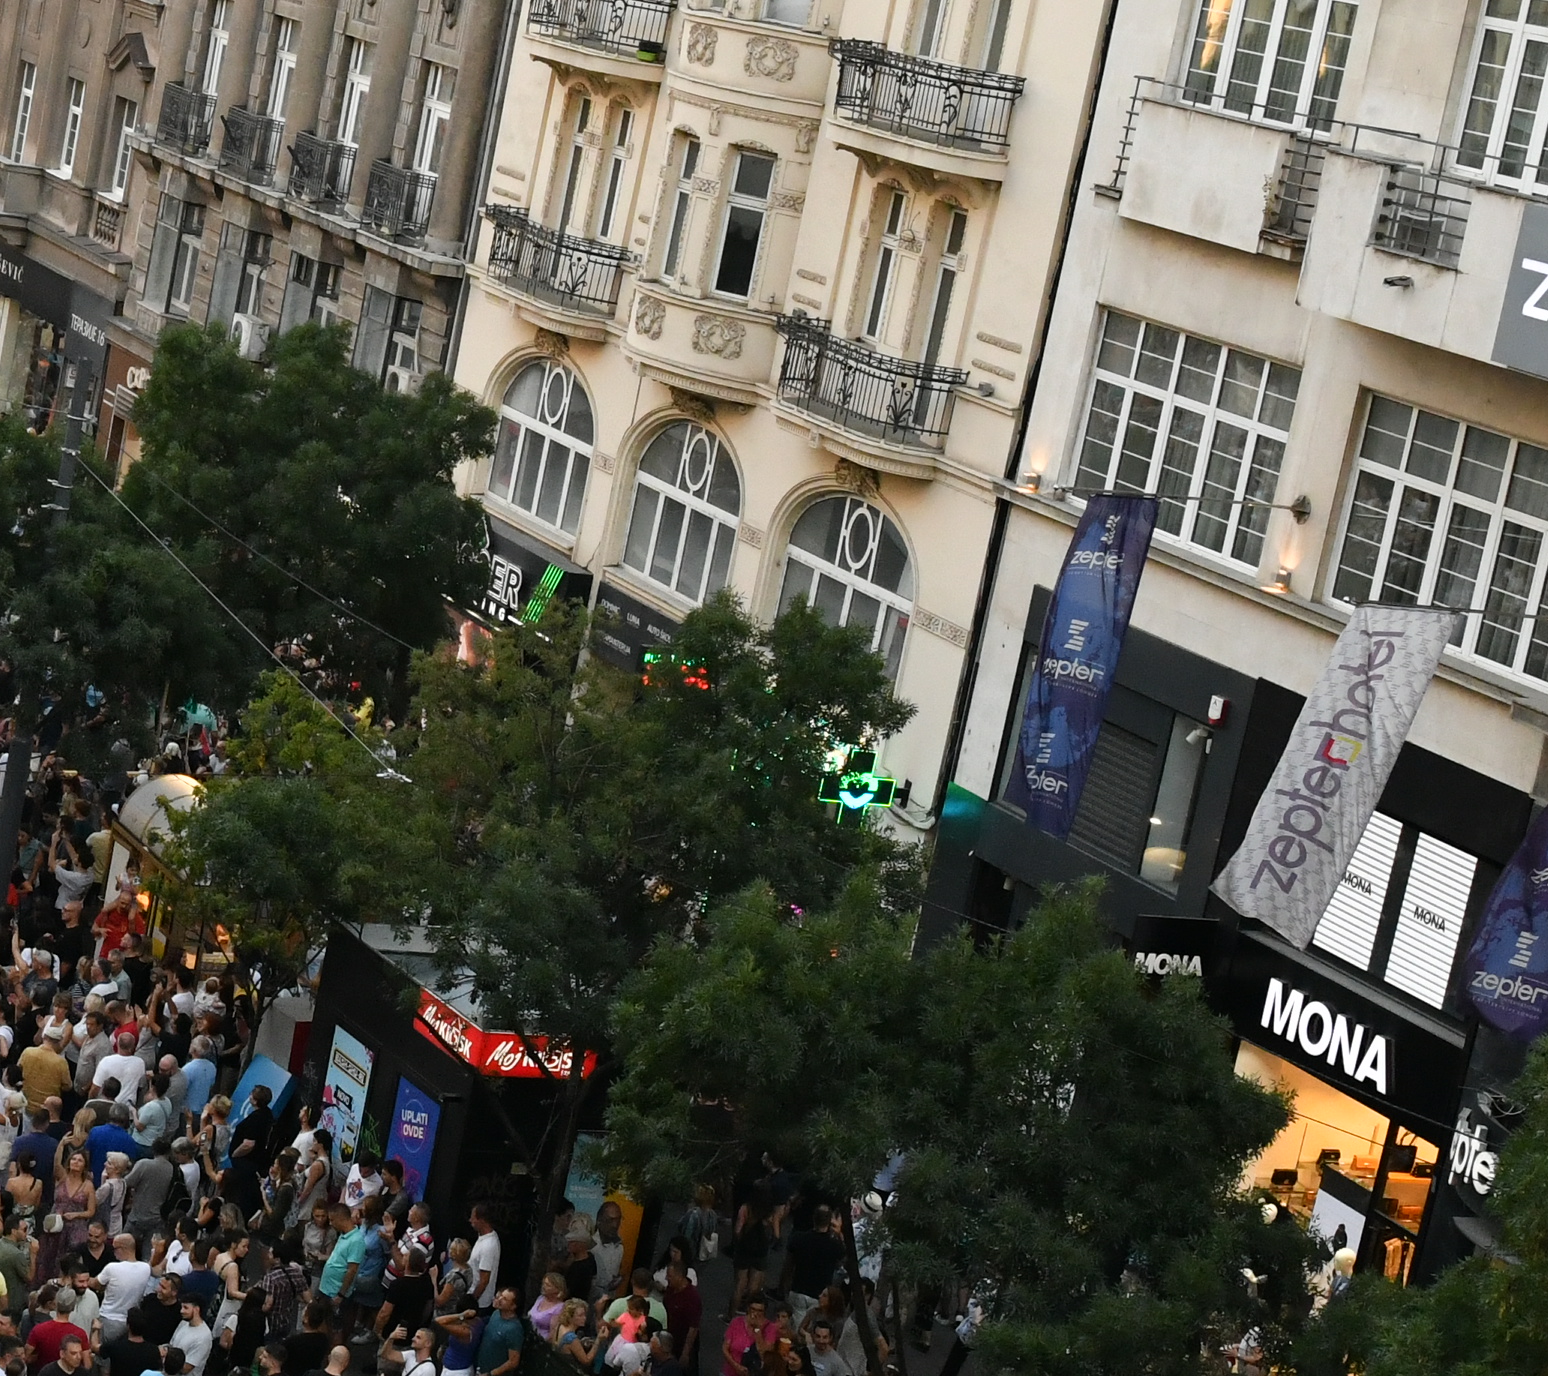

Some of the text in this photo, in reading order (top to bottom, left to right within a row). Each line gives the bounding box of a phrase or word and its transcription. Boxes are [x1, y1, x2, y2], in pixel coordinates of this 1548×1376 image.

[71, 313, 106, 347] ТЕРАЗИЈЕ 16
[1342, 872, 1372, 896] MONA
[1413, 907, 1446, 933] MONA
[1261, 977, 1389, 1095] MONA
[486, 1040, 524, 1072] Moj
[401, 1108, 429, 1126] UPLATI
[402, 1124, 425, 1139] OVDE
